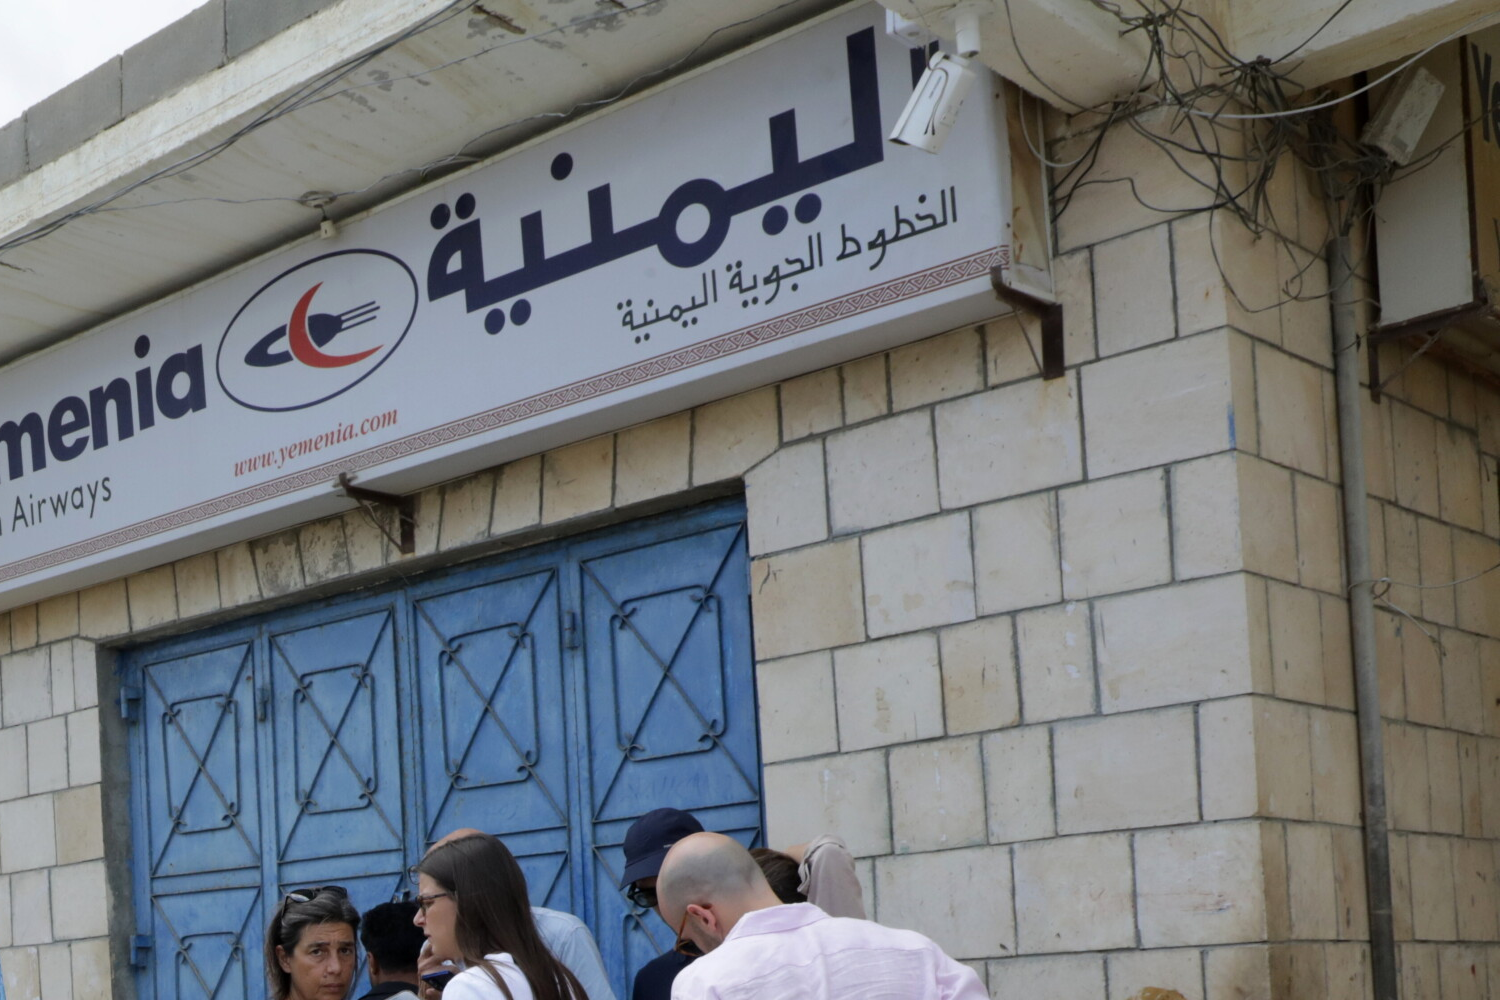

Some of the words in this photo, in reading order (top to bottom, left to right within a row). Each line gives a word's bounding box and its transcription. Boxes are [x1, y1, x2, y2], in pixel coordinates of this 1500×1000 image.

[835, 185, 959, 270] الخطوط
[726, 232, 824, 305] الجوية
[616, 272, 718, 345] اليمنية
[232, 407, 400, 478] www.yemenia.com
[11, 475, 114, 541] Airways
